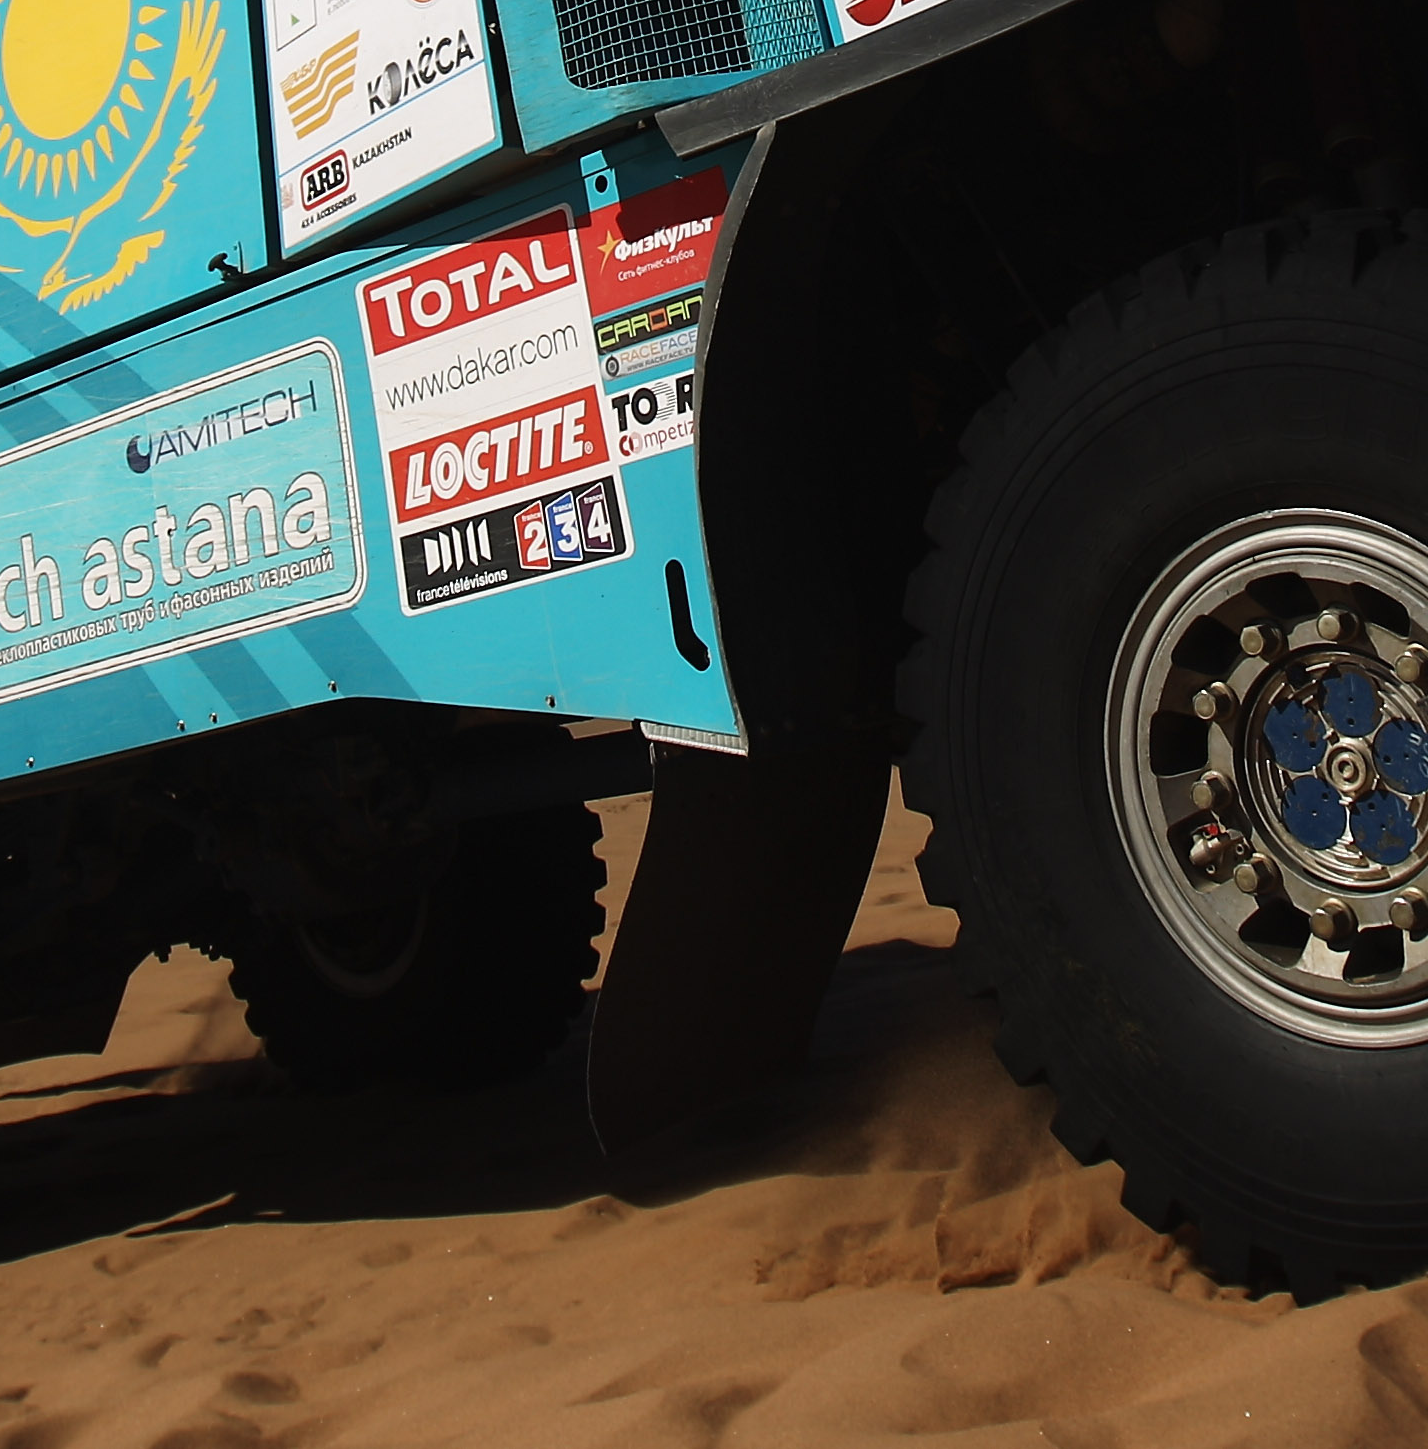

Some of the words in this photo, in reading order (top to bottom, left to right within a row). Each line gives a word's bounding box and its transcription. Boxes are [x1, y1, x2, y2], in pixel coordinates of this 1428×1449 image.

[352, 127, 412, 170] KAZAKHSTAN
[307, 159, 345, 203] ARB
[369, 240, 570, 338] TOTAL
[618, 270, 636, 281] Сеть
[385, 323, 580, 411] www.dakar.com
[619, 329, 697, 364] RACEFACE
[626, 346, 694, 372] WWW.RACEFACE.TV
[150, 379, 317, 466] AMITECH
[404, 398, 587, 511] LOCTITE
[81, 471, 331, 611] astana
[524, 520, 549, 562] 2
[554, 510, 579, 552] 3
[587, 502, 610, 543] 4
[119, 600, 156, 633] труб
[160, 602, 170, 619] и
[170, 575, 255, 618] фасонных
[259, 546, 334, 588] изделий
[416, 568, 509, 604] francetélévisions
